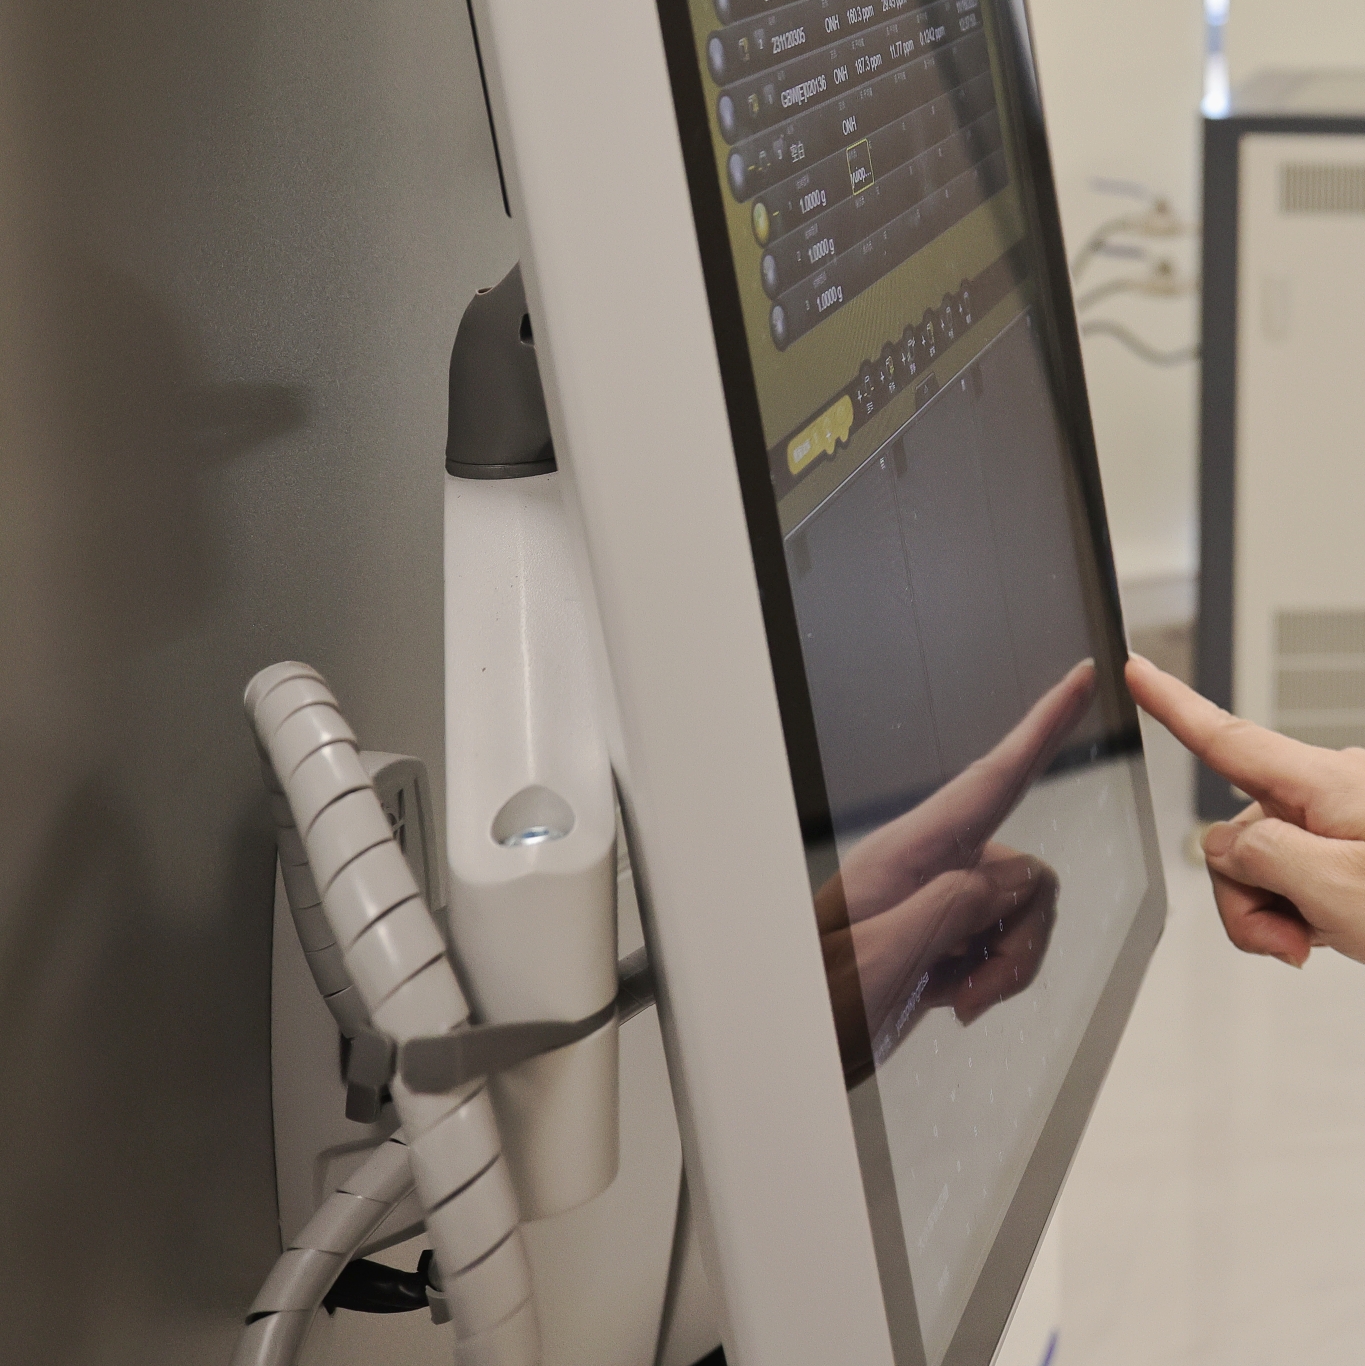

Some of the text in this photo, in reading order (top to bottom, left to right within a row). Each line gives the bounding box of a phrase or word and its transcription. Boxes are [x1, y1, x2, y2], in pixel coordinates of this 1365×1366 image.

[825, 14, 840, 33] ONH
[862, 5, 875, 23] ppm
[833, 65, 848, 85] ONH
[870, 54, 883, 72] ppm
[903, 39, 915, 57] ppm
[935, 25, 946, 42] ppm
[790, 141, 805, 163] 空白
[842, 115, 858, 135] ONH
[821, 189, 827, 206] g
[829, 238, 835, 255] g
[837, 285, 843, 302] g
